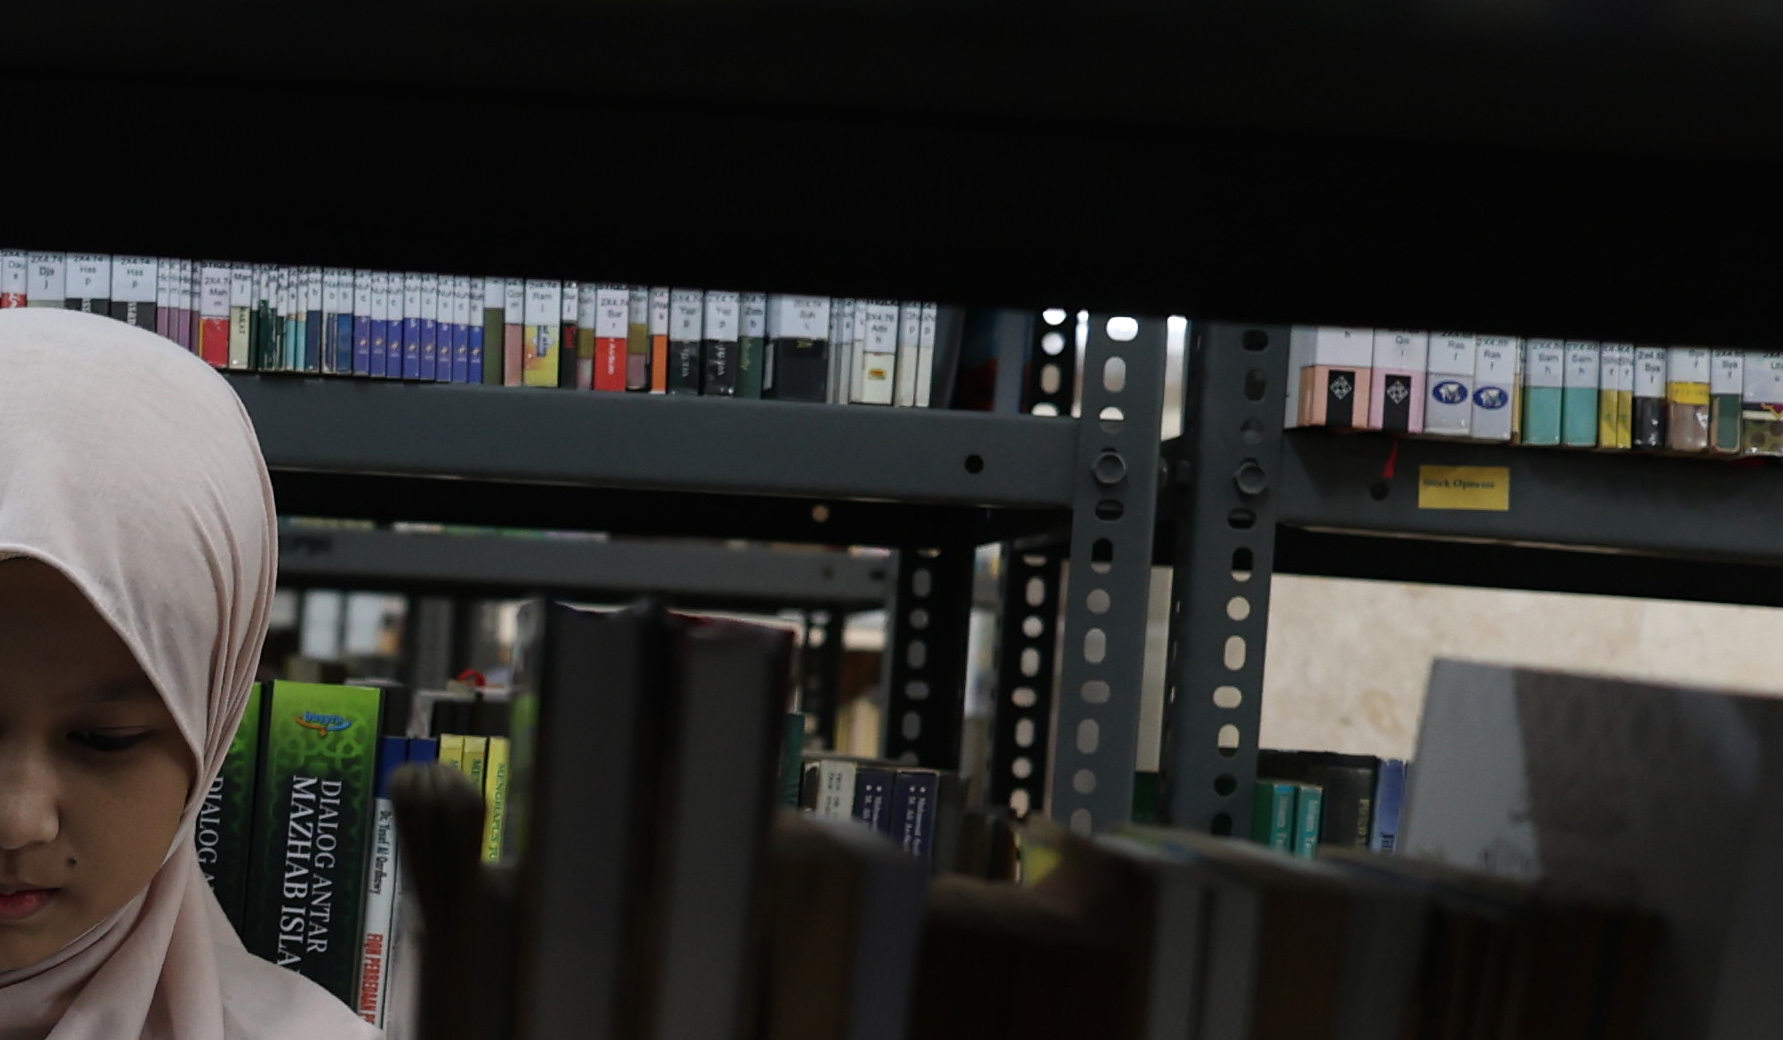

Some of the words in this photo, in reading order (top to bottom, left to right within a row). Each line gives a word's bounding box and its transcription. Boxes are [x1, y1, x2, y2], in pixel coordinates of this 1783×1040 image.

[197, 776, 224, 863] DIALOG
[283, 775, 318, 898] MAZHAB
[315, 780, 342, 869] DIALOG
[378, 846, 387, 854] Al
[276, 905, 306, 978] ISLA
[307, 874, 332, 952] ANTAR
